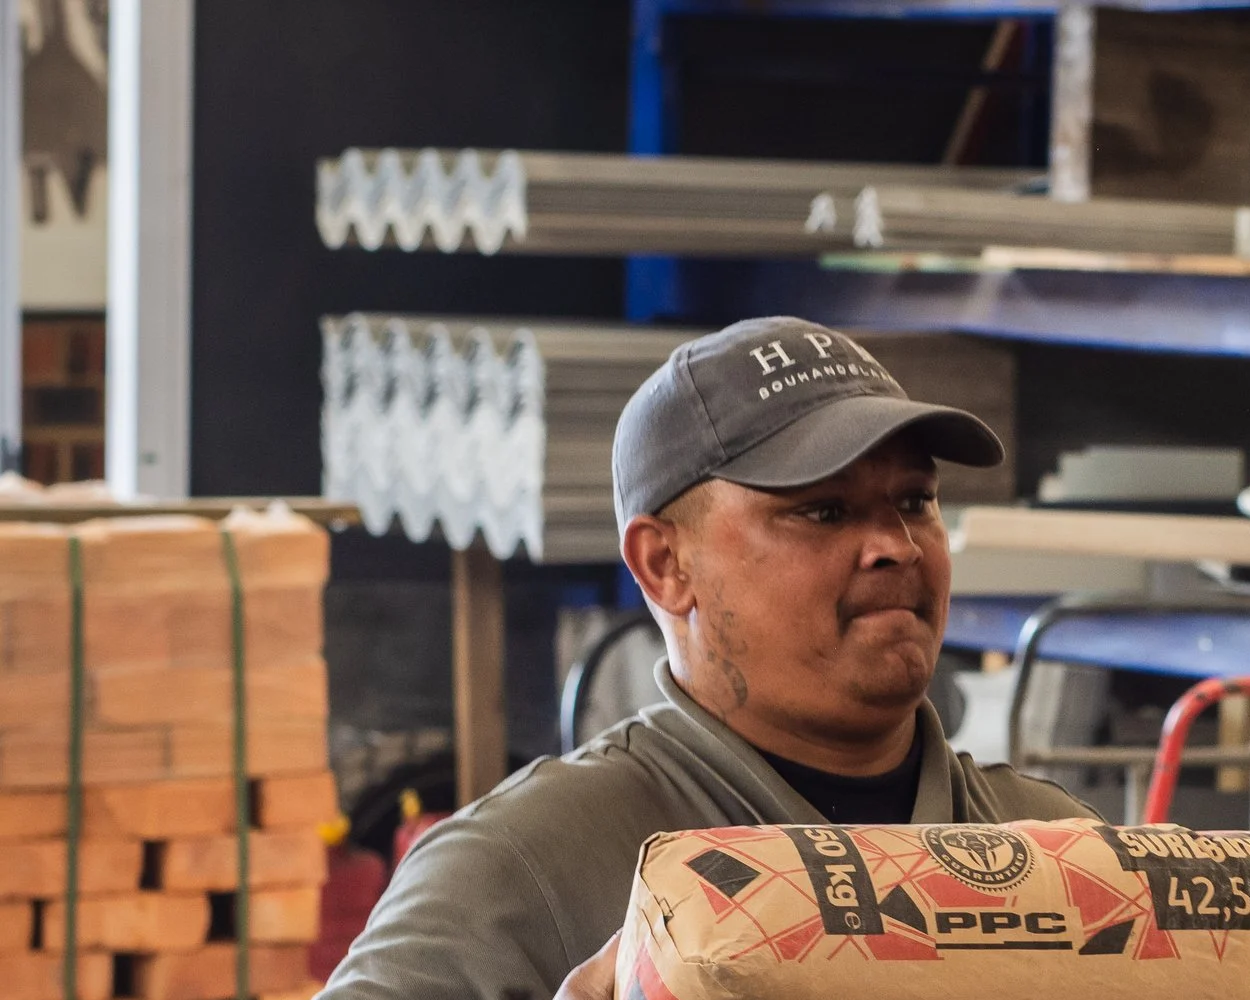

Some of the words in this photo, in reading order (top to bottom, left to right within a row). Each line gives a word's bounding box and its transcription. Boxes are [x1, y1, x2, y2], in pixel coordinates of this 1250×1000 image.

[803, 829, 848, 857] 50
[941, 852, 1026, 883] GUARANTEED
[825, 864, 860, 907] kg
[935, 912, 1067, 934] PPC
